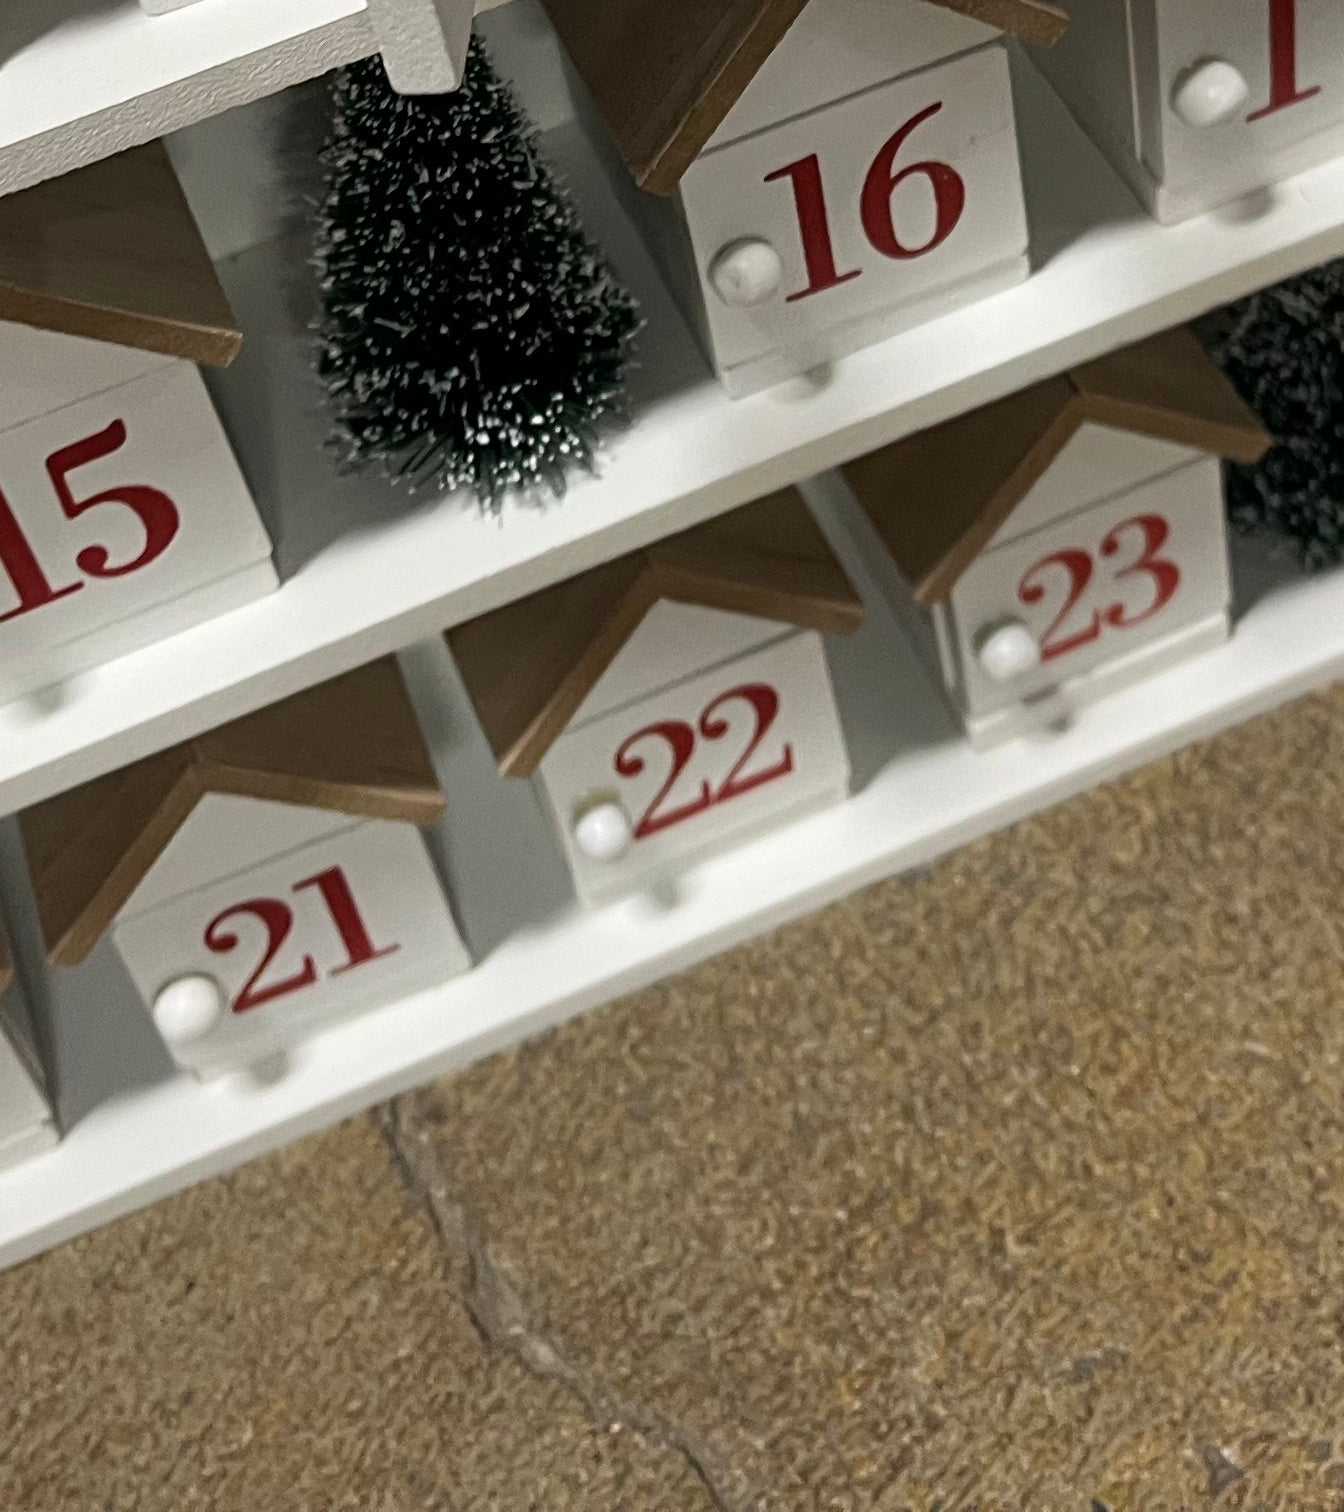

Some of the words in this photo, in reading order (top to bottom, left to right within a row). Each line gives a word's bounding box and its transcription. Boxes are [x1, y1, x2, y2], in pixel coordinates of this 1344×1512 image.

[763, 101, 965, 302] 16
[1019, 514, 1182, 661] 23
[615, 683, 794, 839] 22
[205, 866, 399, 1013] 21
